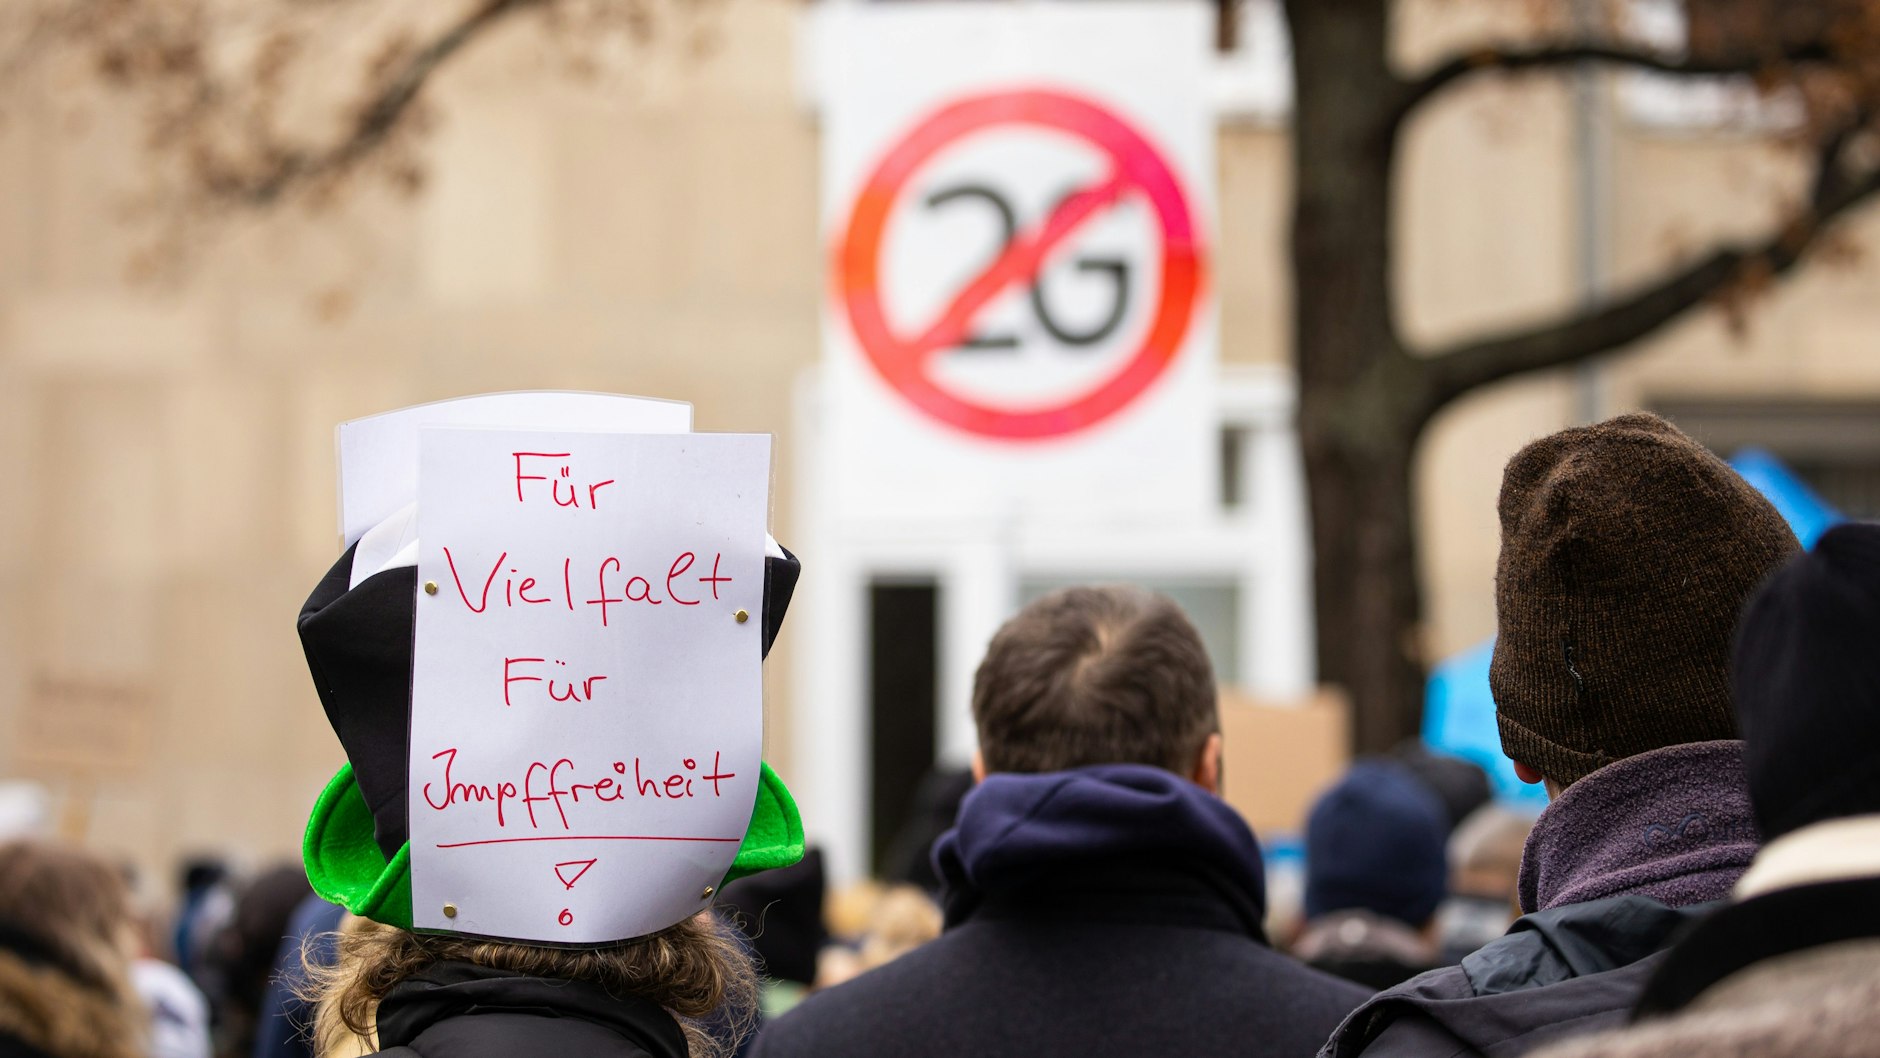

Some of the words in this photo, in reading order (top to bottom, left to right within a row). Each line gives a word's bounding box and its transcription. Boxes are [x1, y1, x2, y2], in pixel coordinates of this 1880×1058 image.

[925, 183, 1130, 348] 2G
[511, 451, 615, 510] Für
[443, 546, 733, 627] Vielfalt
[503, 657, 608, 707] Für
